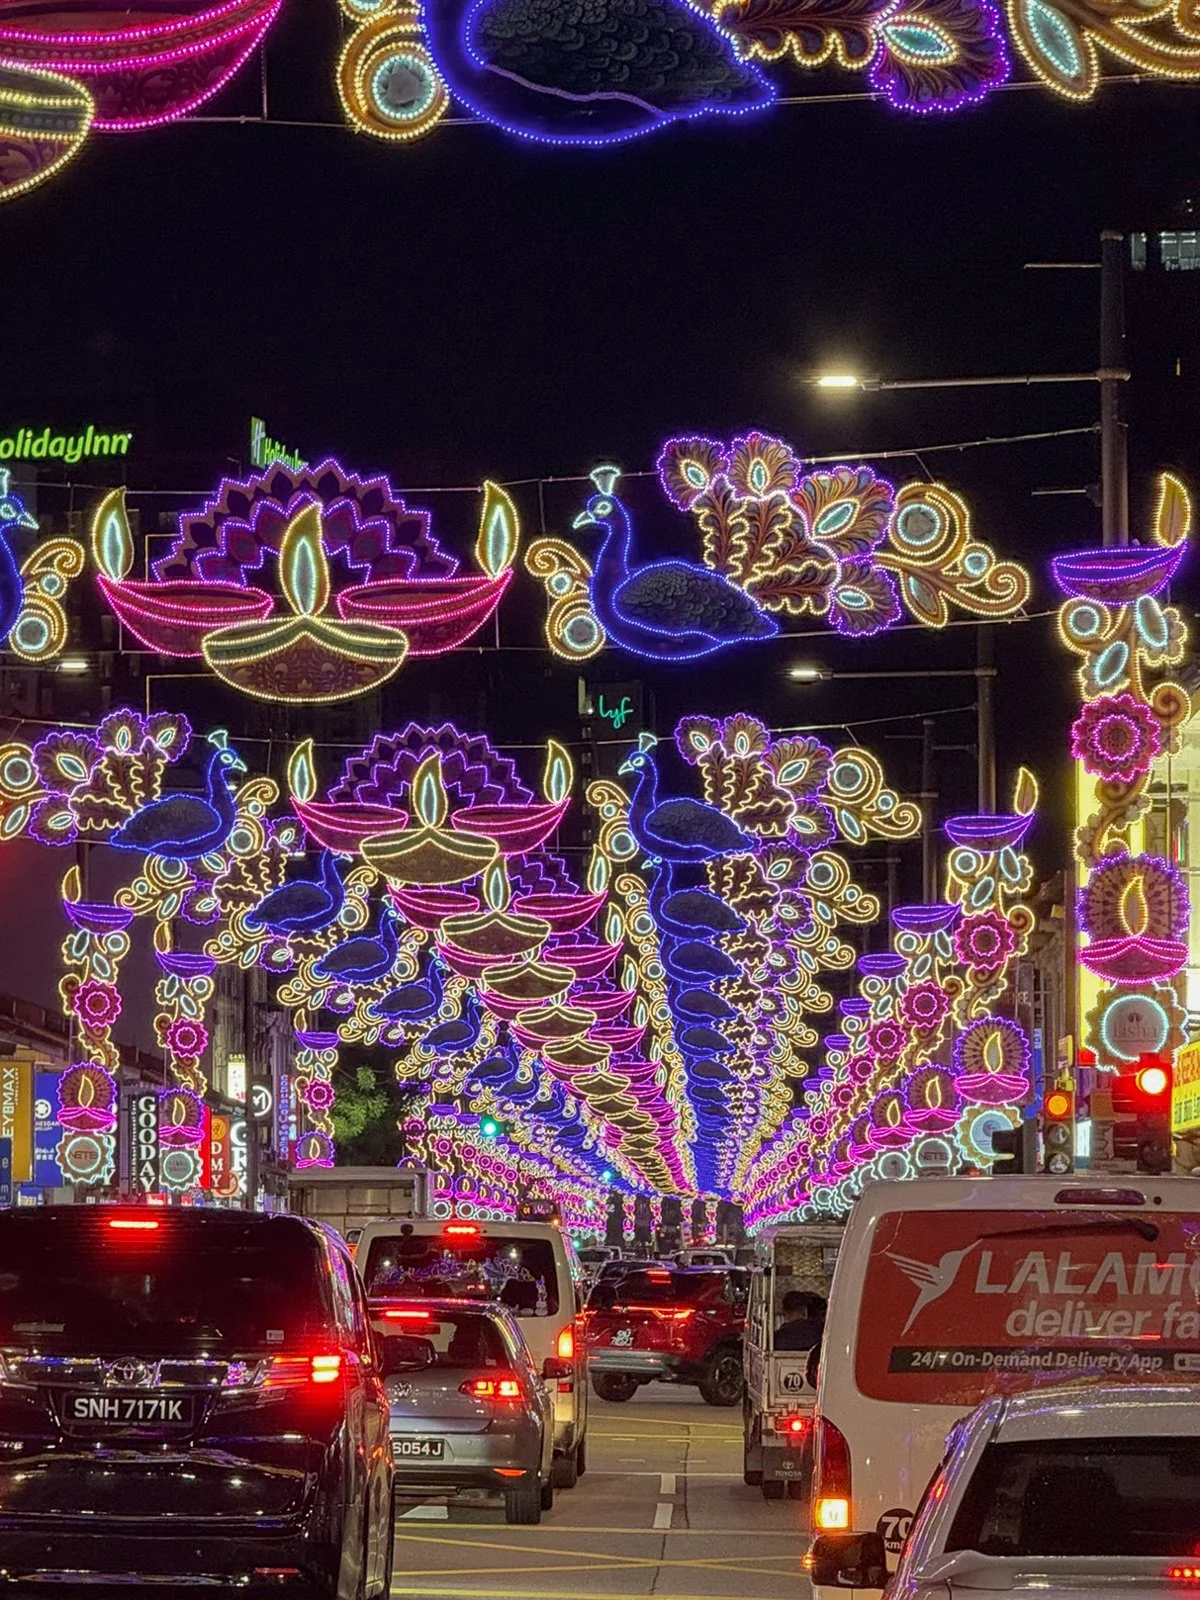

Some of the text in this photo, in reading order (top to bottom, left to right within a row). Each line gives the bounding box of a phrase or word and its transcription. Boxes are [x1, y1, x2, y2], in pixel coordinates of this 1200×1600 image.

[599, 695, 633, 729] lyf
[1114, 1022, 1157, 1038] Lisha
[138, 1096, 157, 1193] GOODAY
[975, 1251, 1200, 1295] LALAM
[1005, 1300, 1151, 1338] deliver
[1163, 1301, 1200, 1339] fa
[910, 1351, 1163, 1370] 24/7 On-Demand Delivery App
[787, 1375, 800, 1385] 70
[881, 1516, 913, 1539] 70
